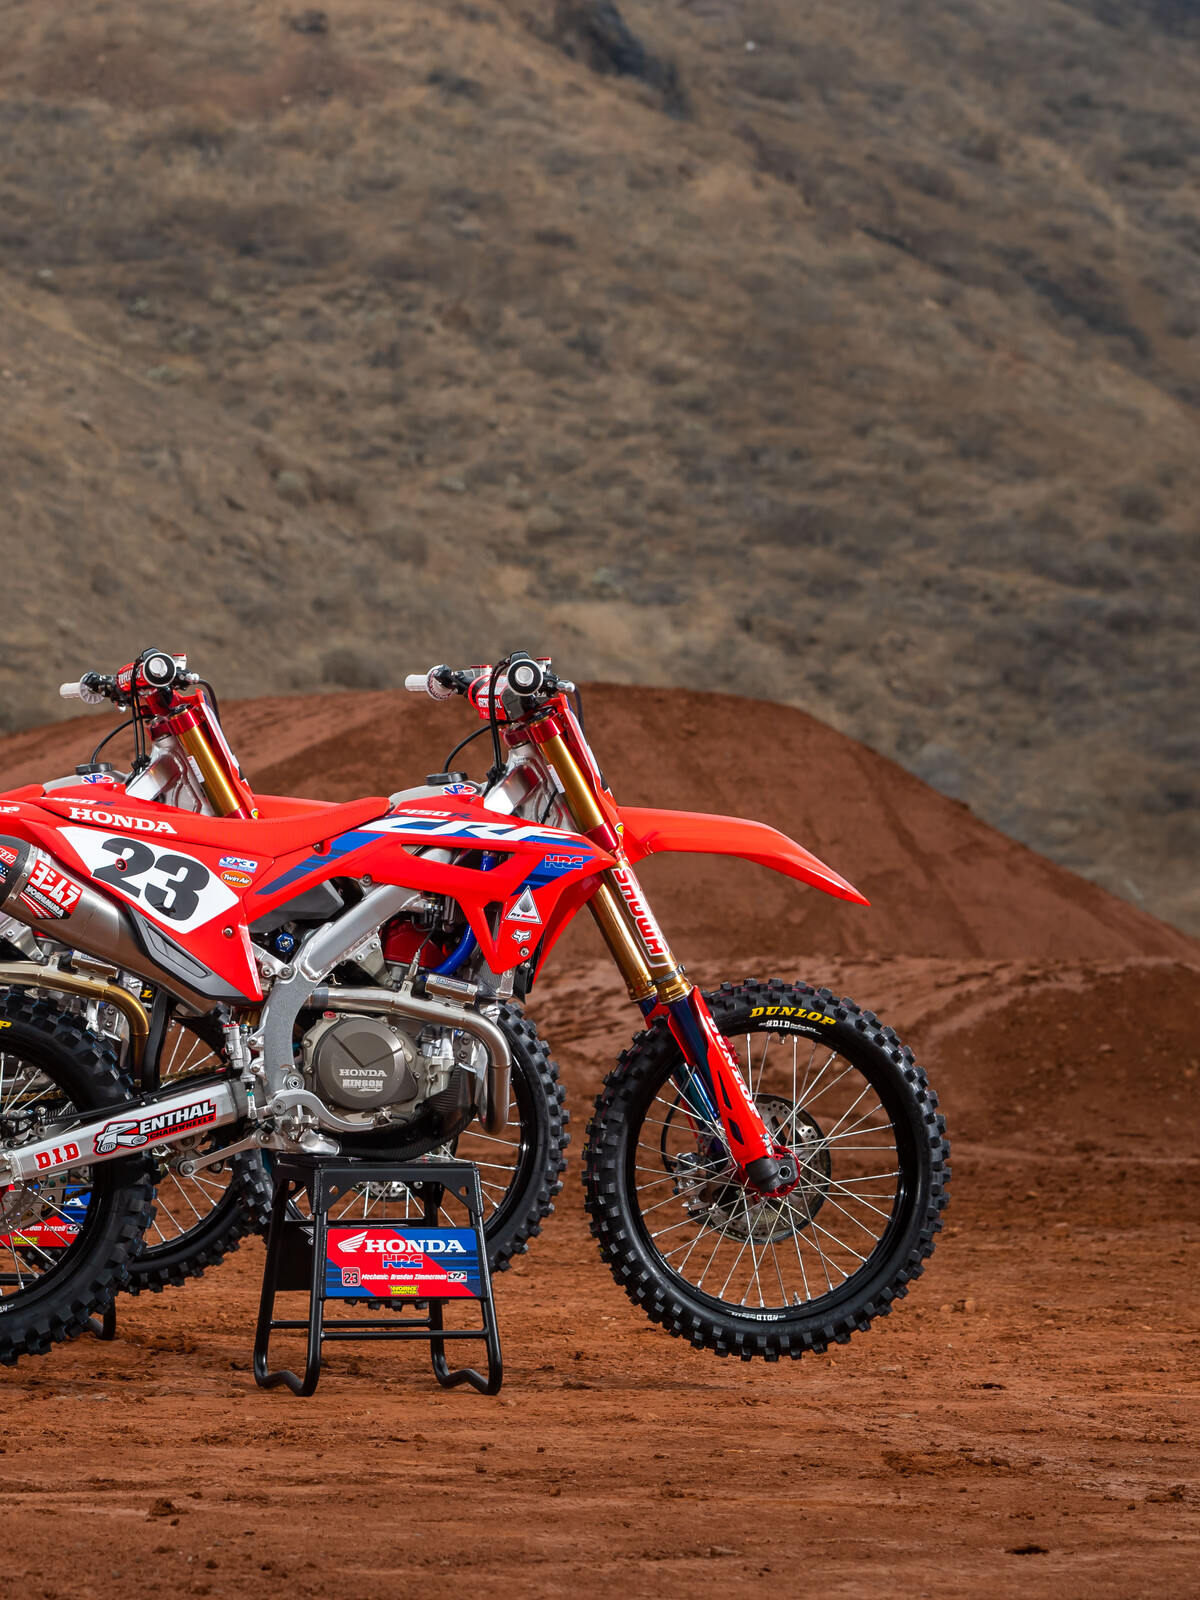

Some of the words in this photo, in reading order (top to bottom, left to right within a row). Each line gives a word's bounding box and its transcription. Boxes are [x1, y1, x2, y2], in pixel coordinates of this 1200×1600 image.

[68, 806, 178, 835] HONDA
[398, 808, 473, 820] 450R
[357, 816, 583, 842] CRF
[545, 856, 583, 870] HRC
[29, 862, 81, 908] ヨシムラ
[91, 837, 211, 922] 23
[223, 873, 240, 882] Twin
[239, 877, 251, 885] Air
[23, 884, 65, 917] YOSHIMURA
[749, 1006, 837, 1025] DUNLOP
[339, 1068, 388, 1078] HONDA
[96, 1101, 216, 1155] RENTHAL
[150, 1114, 215, 1140] CHAINWHEELS
[35, 1142, 80, 1170] D.I.D
[364, 1239, 467, 1253] HONDA
[382, 1254, 424, 1269] HRC
[343, 1272, 359, 1285] 23
